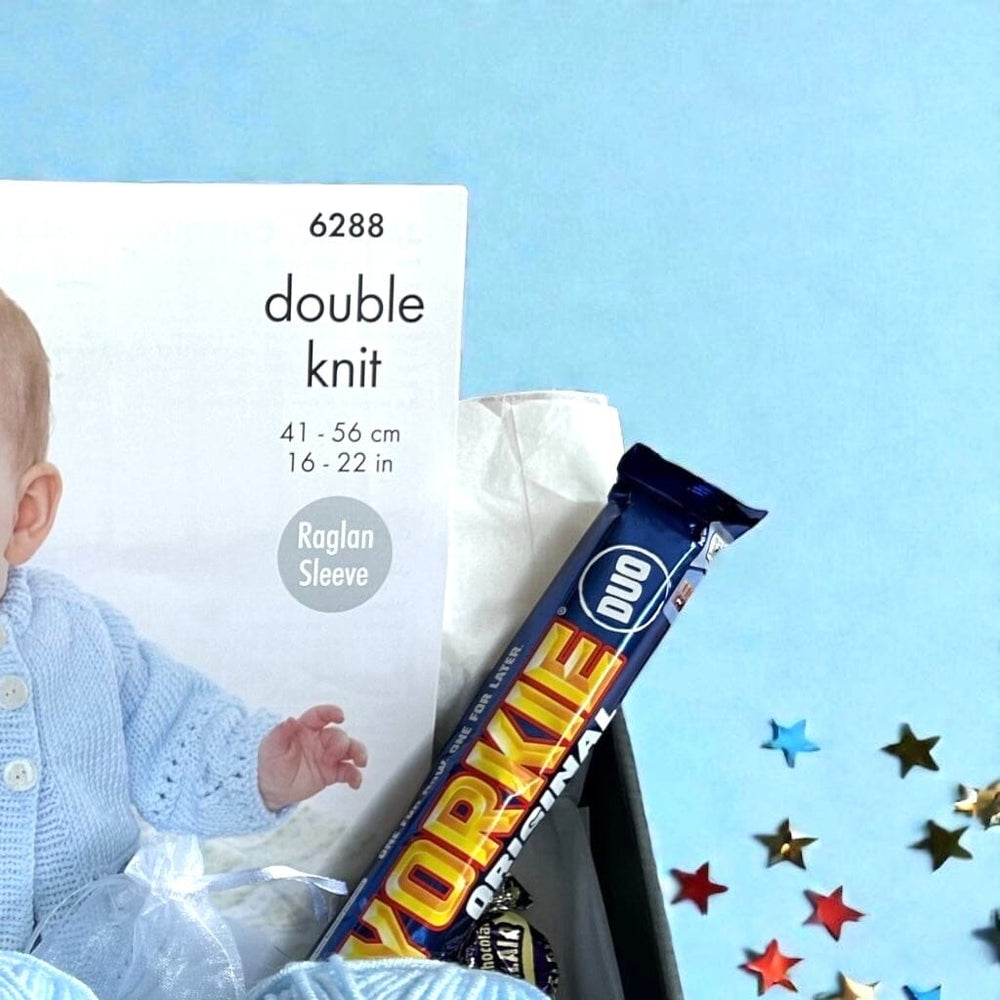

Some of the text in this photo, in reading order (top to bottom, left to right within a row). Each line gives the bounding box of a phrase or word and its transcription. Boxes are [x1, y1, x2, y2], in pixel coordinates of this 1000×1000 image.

[309, 212, 384, 238] 6288
[264, 273, 425, 323] double
[306, 339, 382, 388] knit
[280, 421, 306, 443] 41
[331, 421, 362, 443] 56
[370, 428, 400, 443] cm
[289, 452, 315, 473] 16
[337, 452, 366, 473] 22
[375, 452, 393, 473] in
[297, 519, 374, 555] Raglan
[299, 557, 369, 587] Sleeve
[596, 554, 652, 624] DUO
[449, 726, 473, 755] ONE
[468, 692, 492, 723] FOR
[337, 617, 627, 959] YORKIE
[466, 707, 617, 920] ORIGINAL
